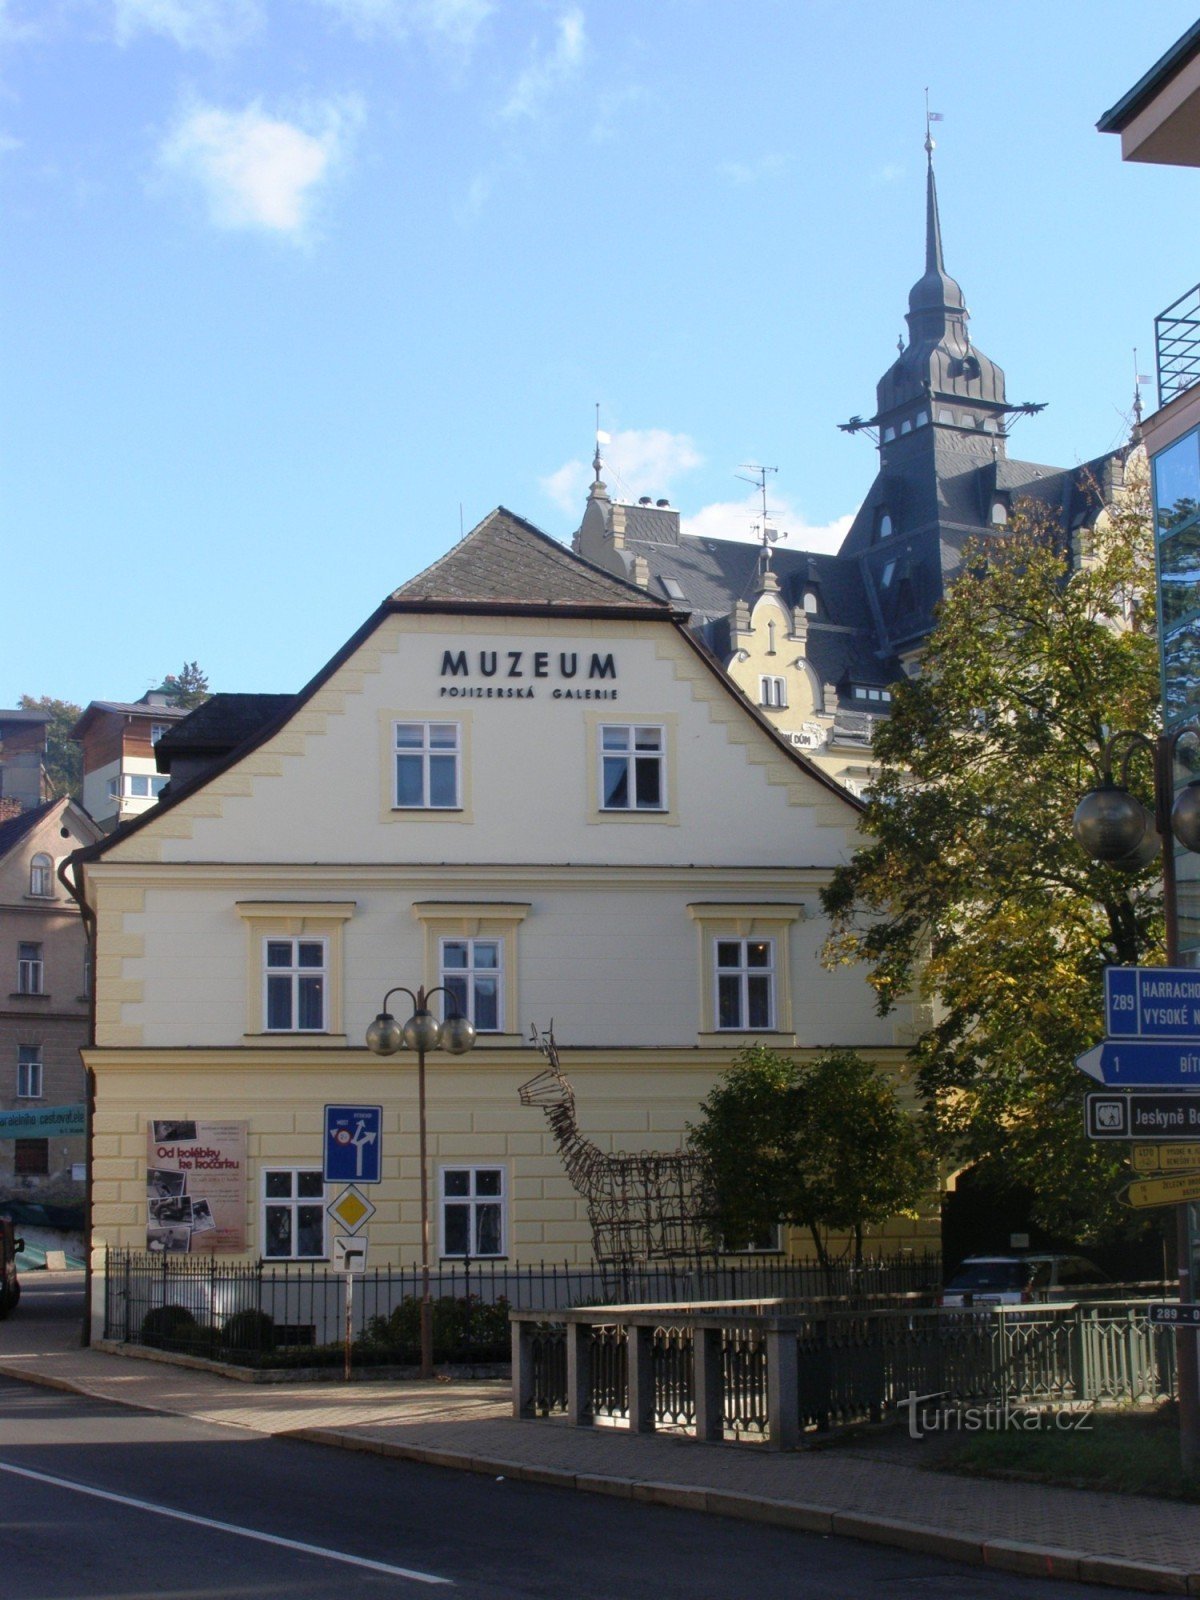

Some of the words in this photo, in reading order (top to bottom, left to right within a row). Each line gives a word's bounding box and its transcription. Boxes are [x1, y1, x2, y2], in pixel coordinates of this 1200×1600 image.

[440, 650, 617, 679] MUZEUM
[440, 685, 535, 699] POJIZERSKÁ
[552, 688, 618, 700] GALERIE
[1112, 994, 1135, 1011] 289
[1143, 1004, 1188, 1025] VYSOKÉ
[1113, 1056, 1120, 1072] 1
[1180, 1052, 1200, 1073] BÍT
[1136, 1107, 1184, 1128] Jeskyně
[156, 1146, 175, 1158] Od
[178, 1158, 193, 1169] ke
[1156, 1308, 1178, 1320] 289
